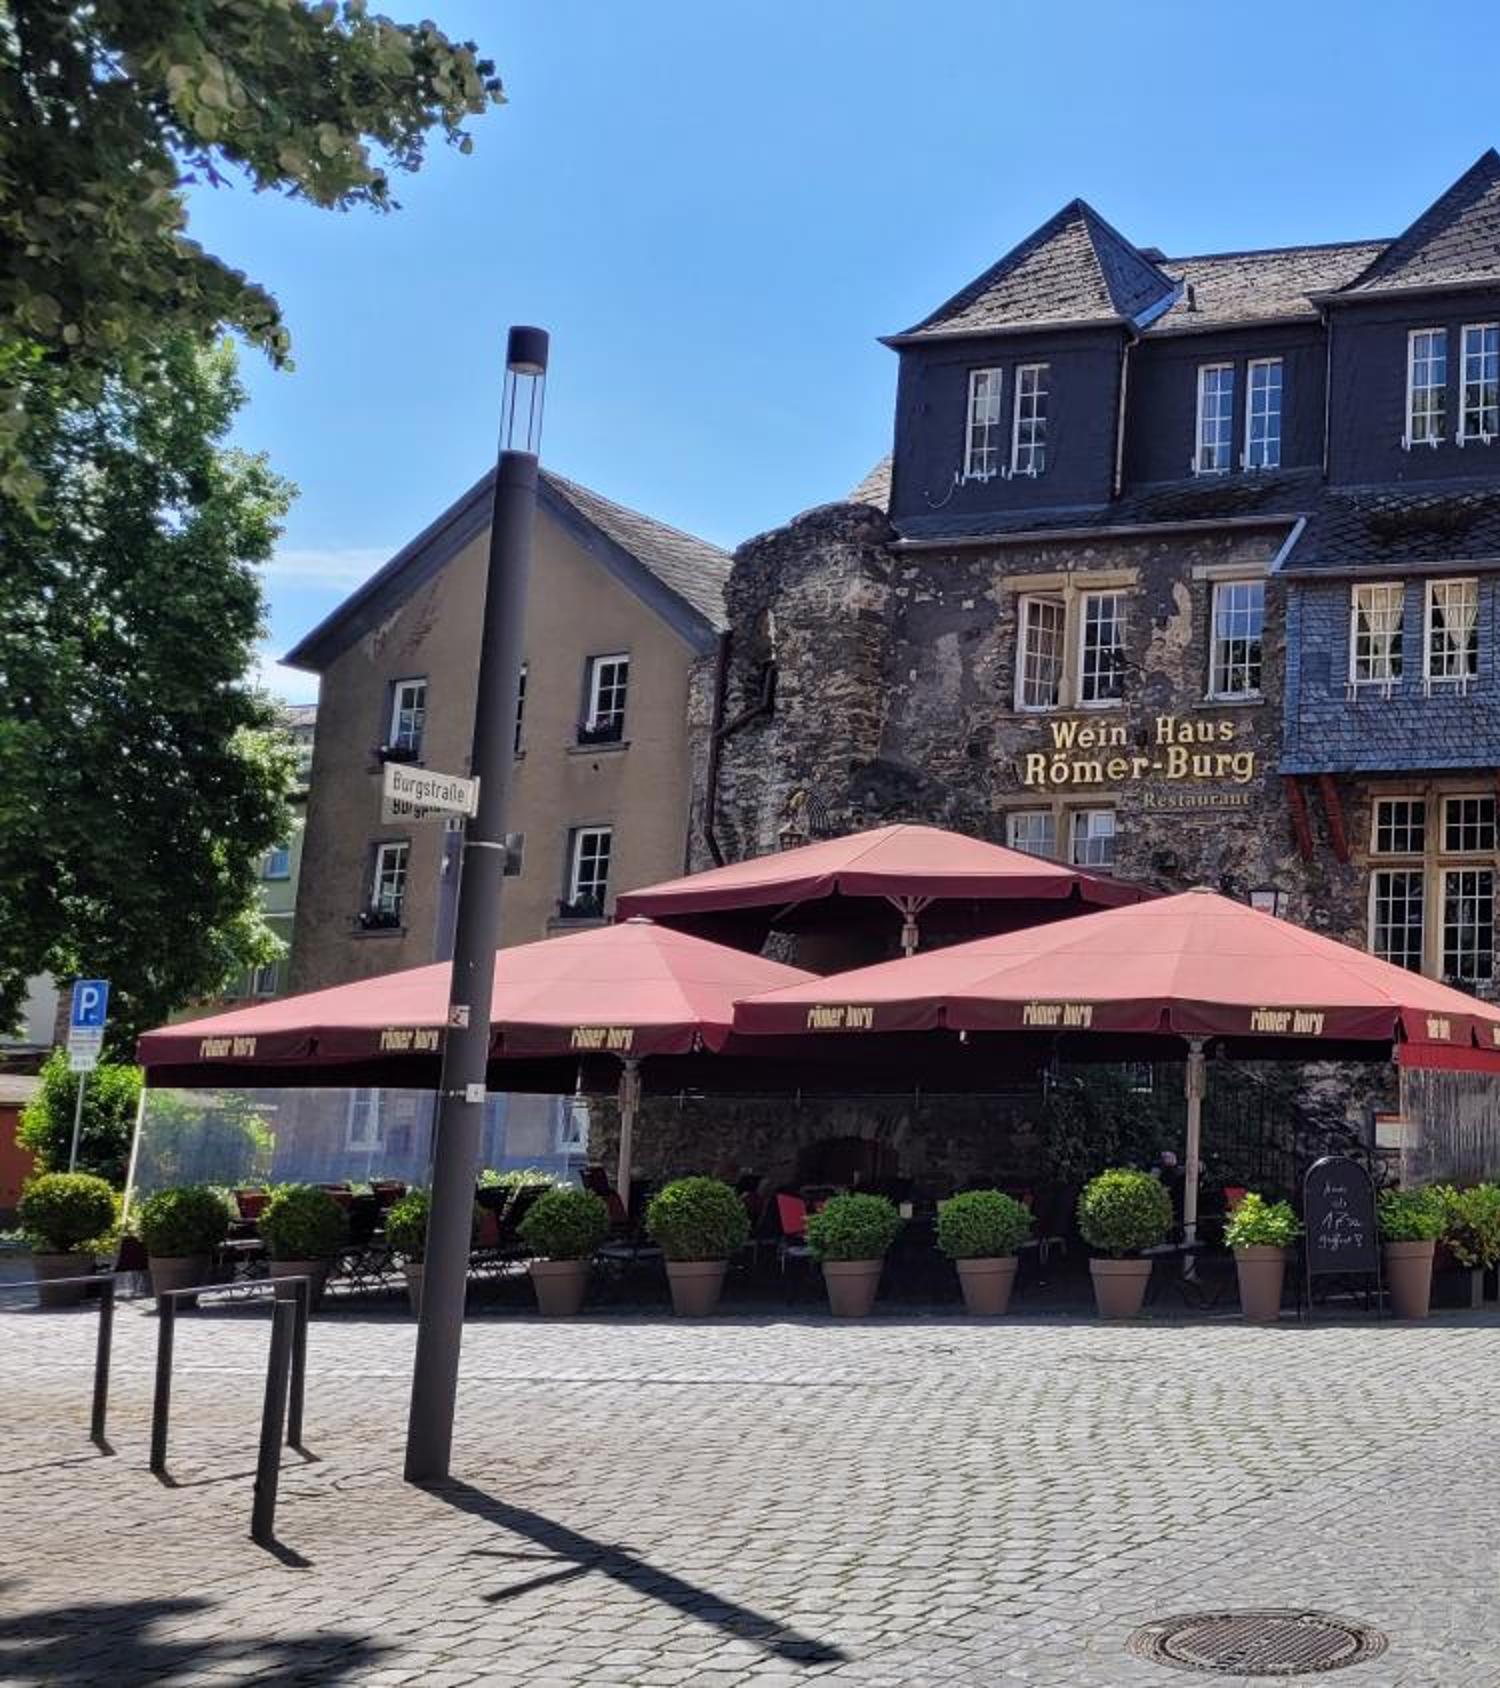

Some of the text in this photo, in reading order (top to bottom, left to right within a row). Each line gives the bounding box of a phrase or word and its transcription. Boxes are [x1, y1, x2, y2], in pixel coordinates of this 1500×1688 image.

[1050, 716, 1235, 749] Wein Haus
[1023, 744, 1255, 786] Römer-Burg
[393, 771, 465, 803] Burgstraße
[1143, 792, 1249, 808] Restaurant
[80, 987, 99, 1021] P
